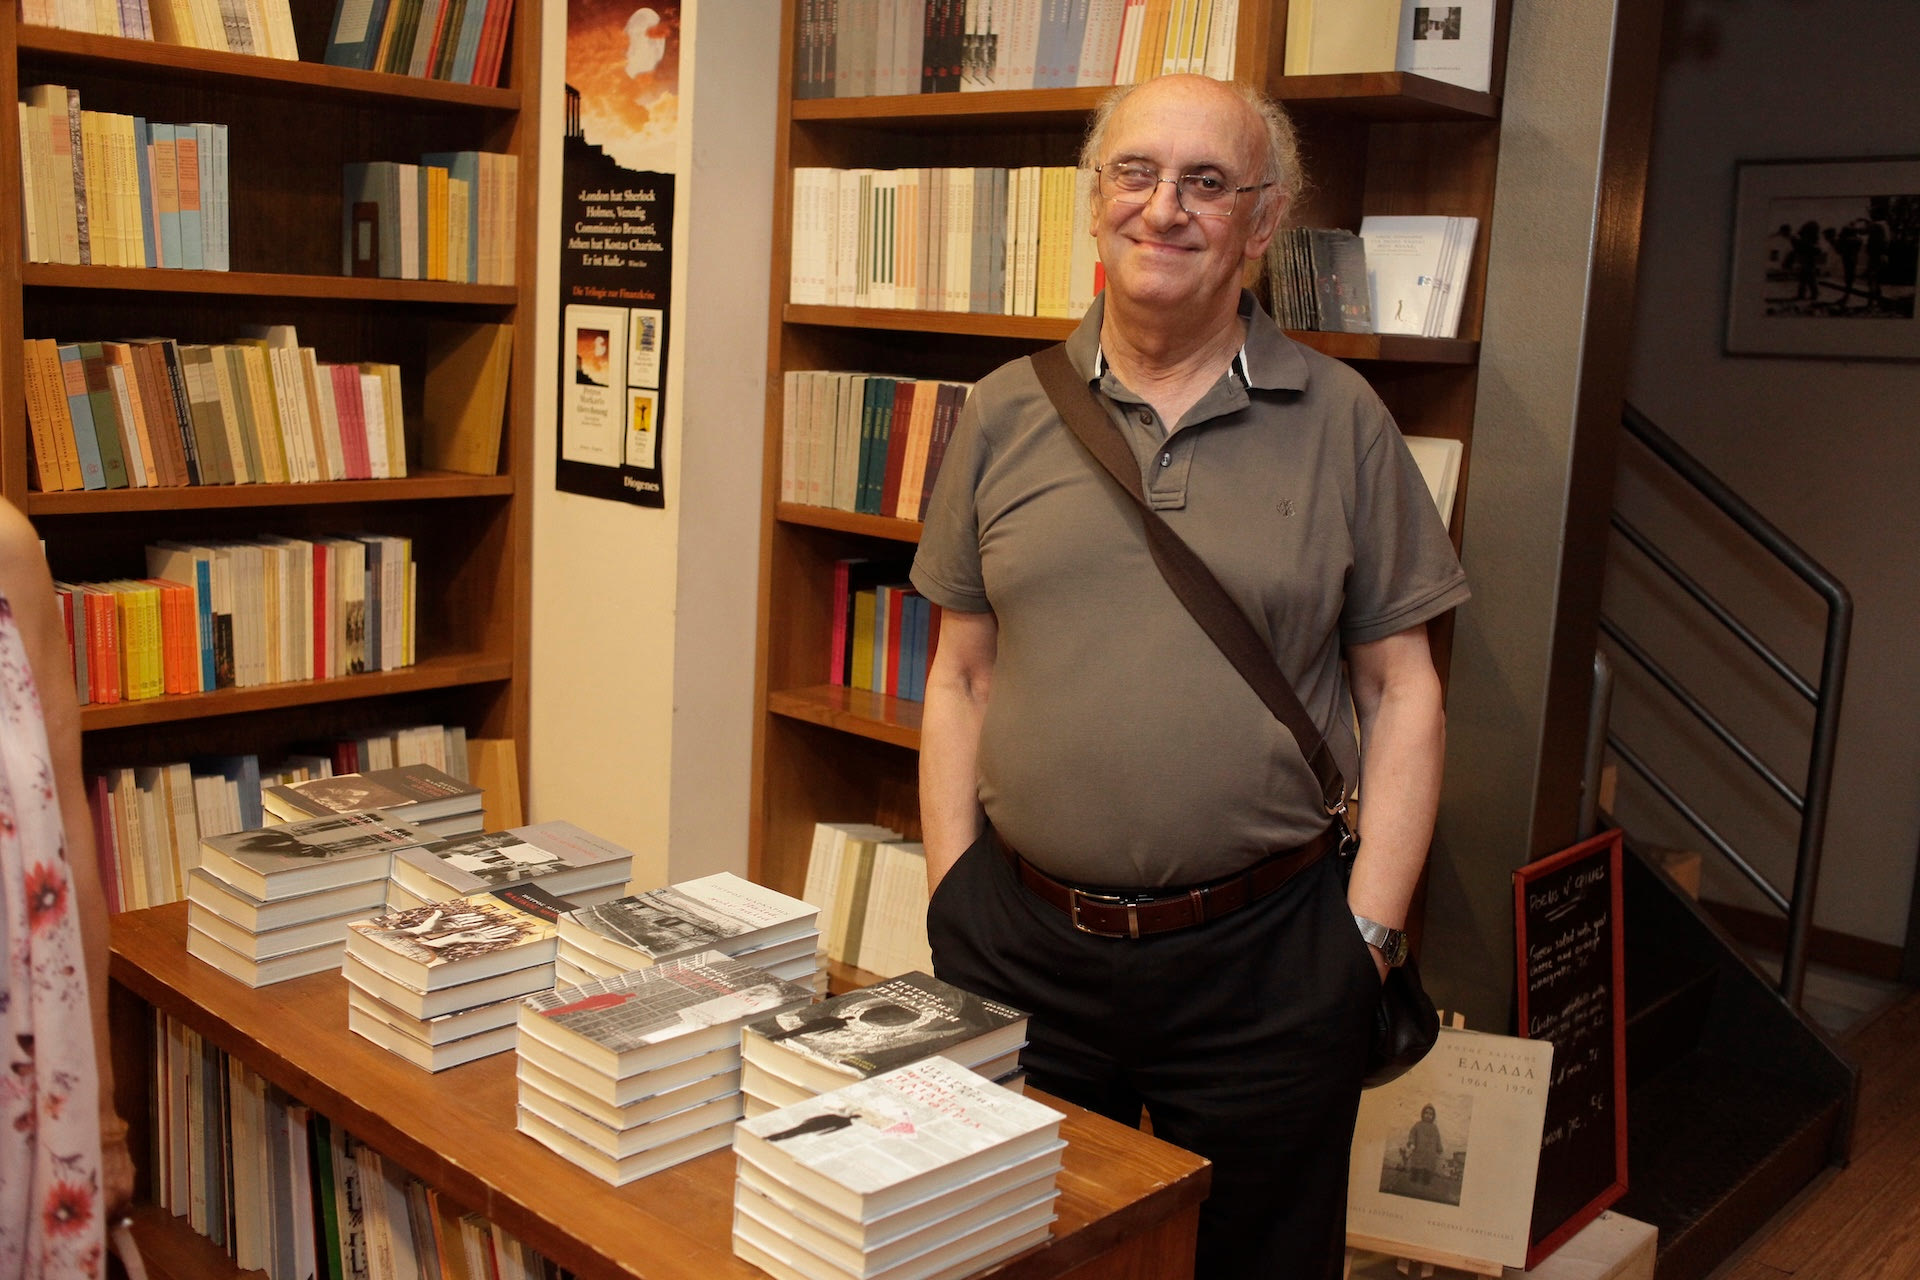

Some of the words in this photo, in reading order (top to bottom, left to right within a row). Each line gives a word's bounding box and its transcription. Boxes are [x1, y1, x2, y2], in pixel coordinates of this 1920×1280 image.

[624, 189, 656, 201] Sherlock
[624, 476, 660, 492] Diogenes
[887, 983, 954, 1012] ΜΑΡΚΑΡΗΣ
[1459, 1058, 1534, 1080] ΕΛΛΑΔΑ
[1461, 1076, 1488, 1088] 1964
[1506, 1083, 1534, 1096] 1976
